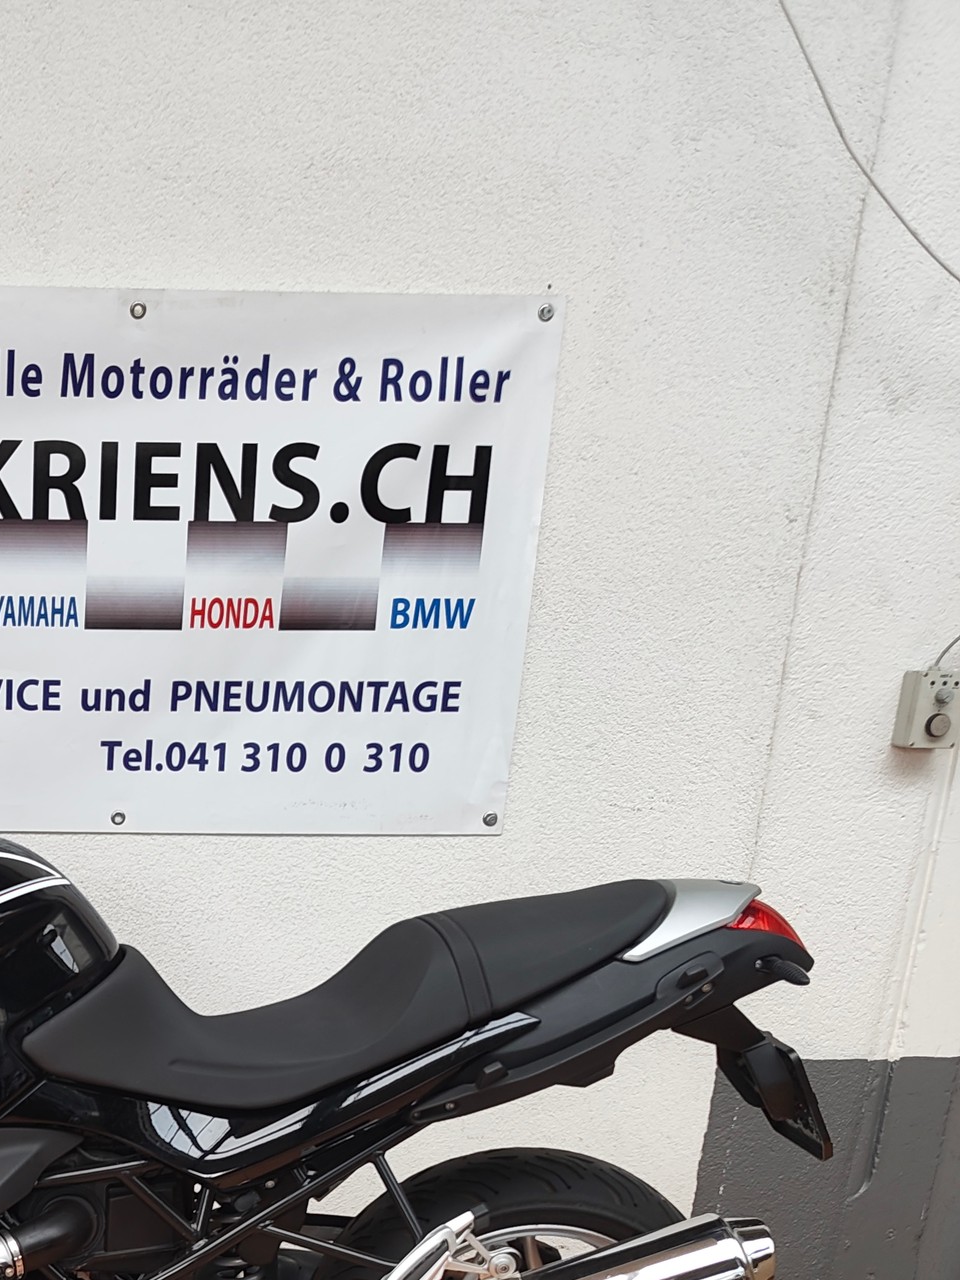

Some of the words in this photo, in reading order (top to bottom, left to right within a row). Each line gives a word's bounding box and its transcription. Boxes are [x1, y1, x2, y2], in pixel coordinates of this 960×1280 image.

[60, 352, 318, 402] Motorräder
[332, 357, 363, 403] &
[379, 356, 512, 404] Roller
[188, 596, 275, 630] HONDA
[389, 597, 477, 631] BMW
[80, 678, 152, 713] und
[170, 680, 462, 714] PNEUMONTAGE
[100, 739, 228, 773] Tel.041
[240, 741, 308, 773] 310
[324, 742, 347, 774] 0
[362, 741, 431, 774] 310
